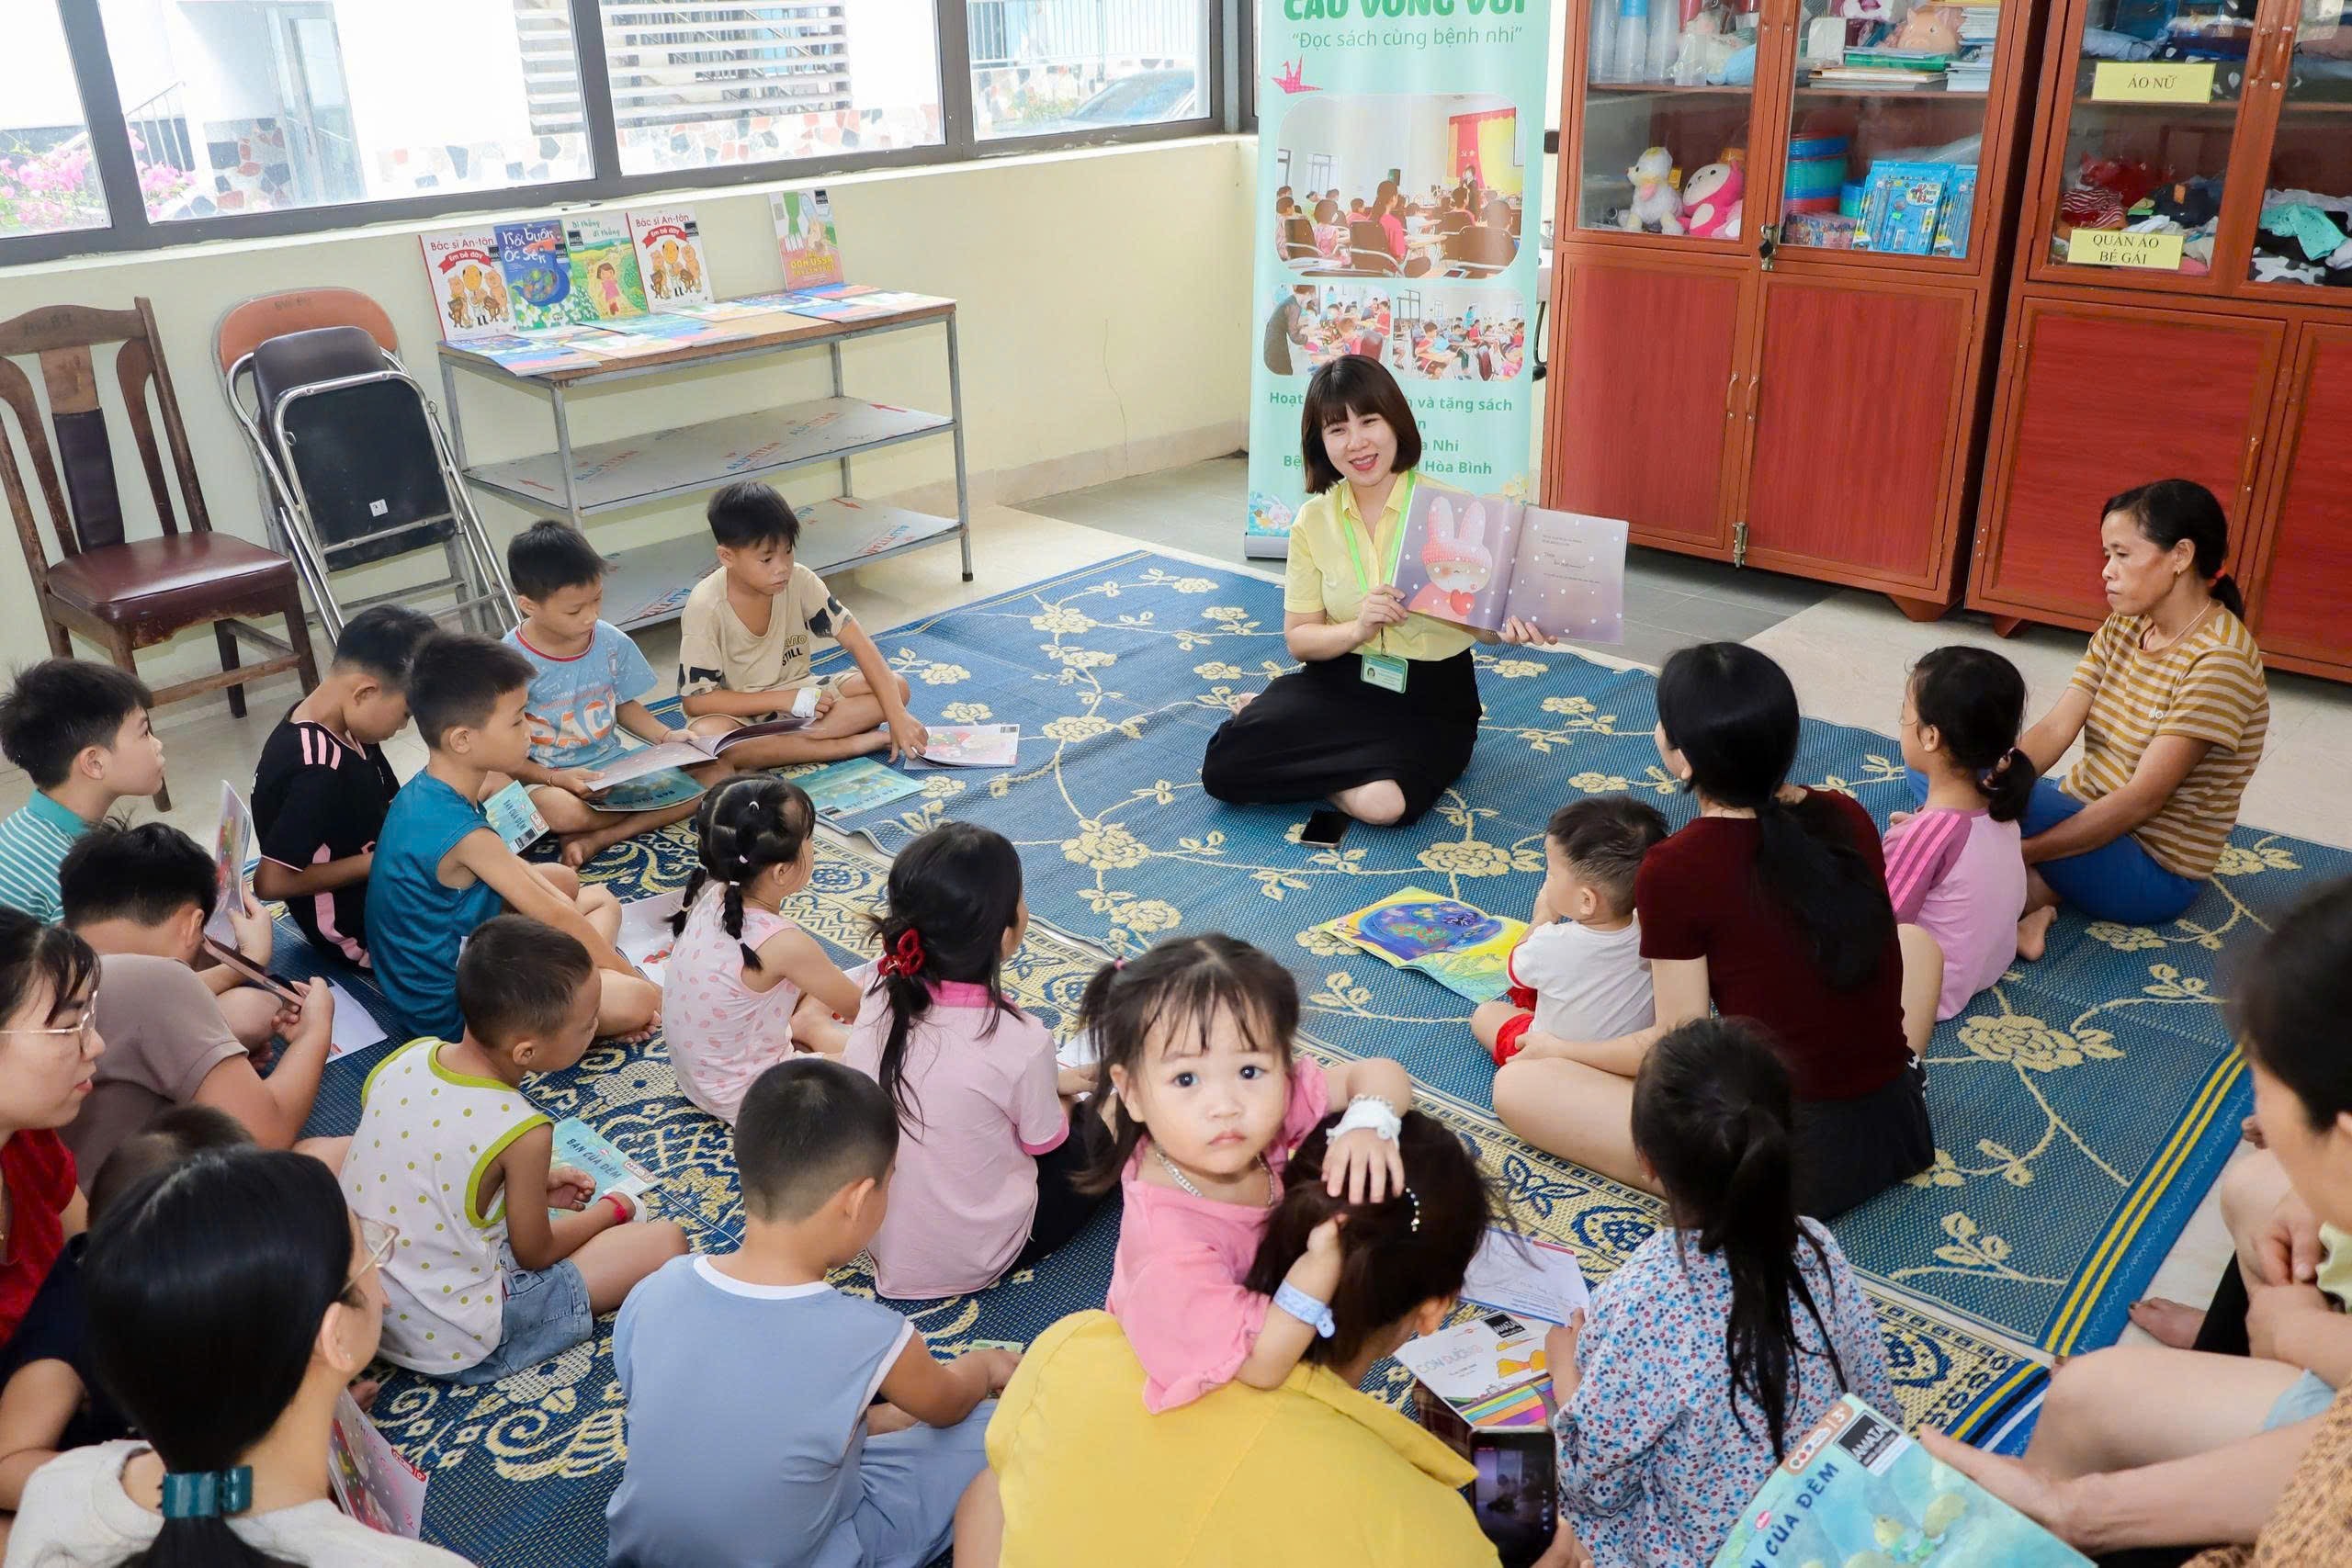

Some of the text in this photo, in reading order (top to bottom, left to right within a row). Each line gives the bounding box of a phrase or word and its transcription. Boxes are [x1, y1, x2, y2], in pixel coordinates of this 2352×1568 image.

[1337, 29, 1377, 47] sách
[1383, 28, 1427, 51] cùng
[1433, 26, 1479, 49] bệnh
[2127, 73, 2150, 89] ÁO
[2099, 249, 2147, 265] BÉ GÁI
[1418, 397, 1434, 409] và
[1478, 399, 1513, 412] sách
[1433, 440, 1459, 452] Nhi
[1425, 460, 1453, 473] Hòa
[1796, 1462, 1839, 1508] ĐÊM
